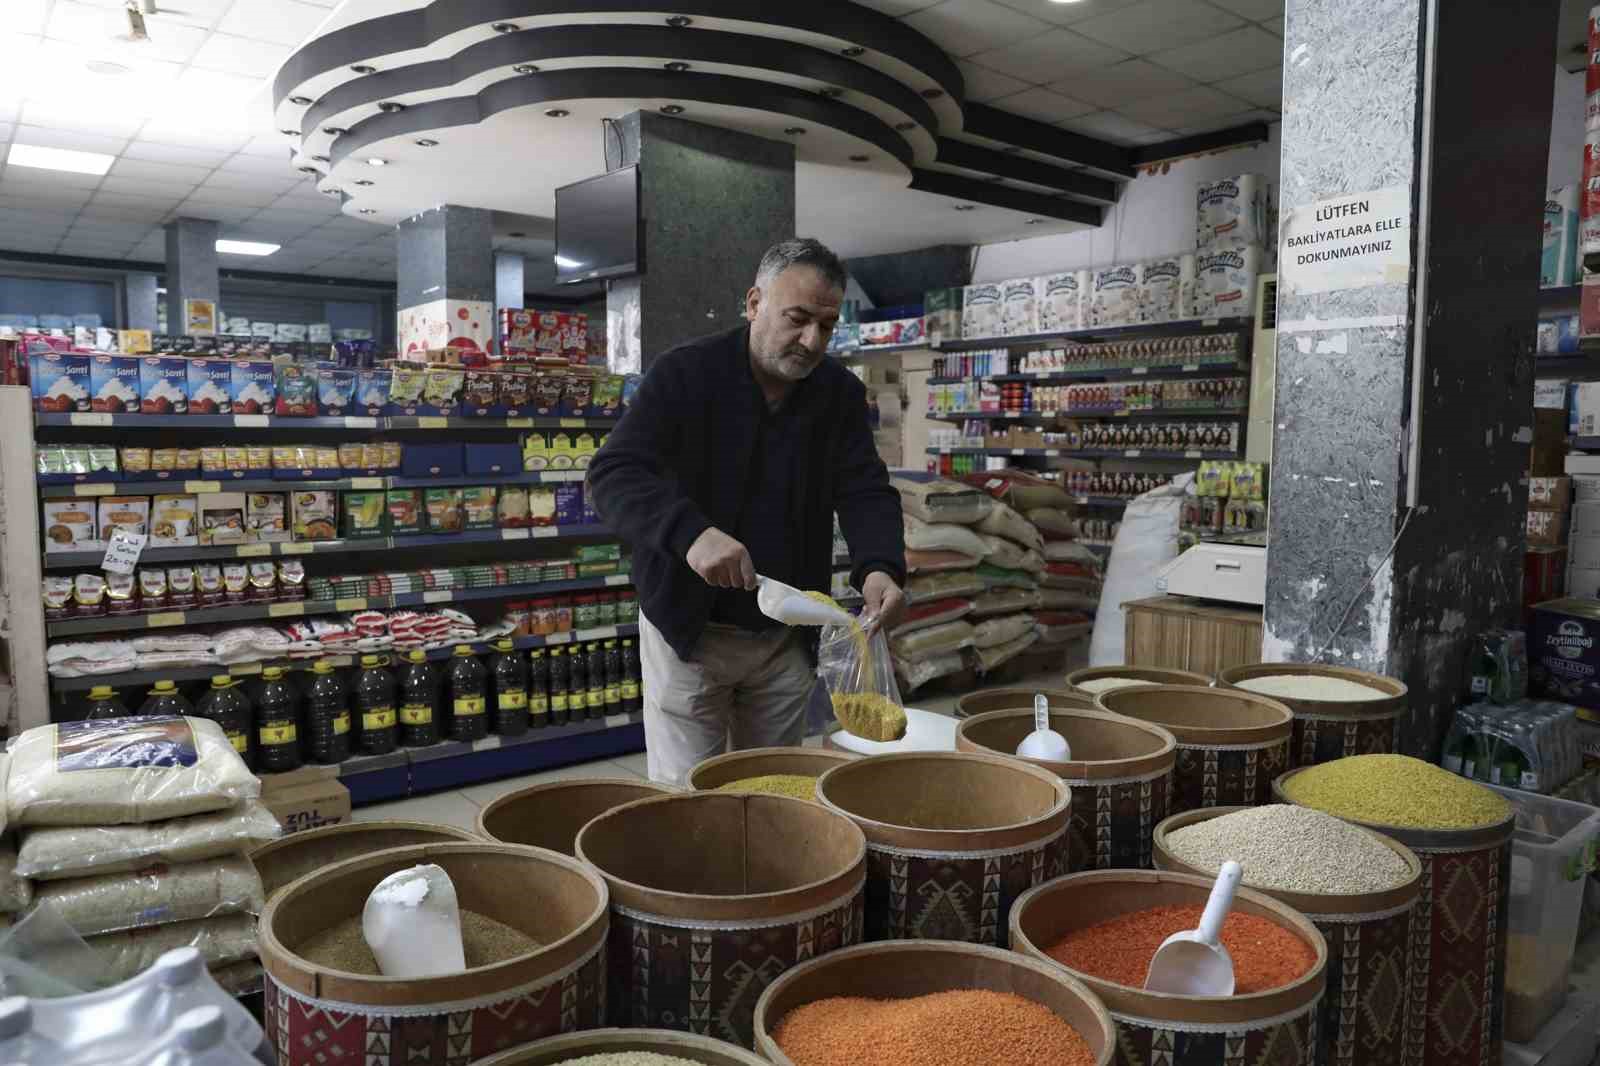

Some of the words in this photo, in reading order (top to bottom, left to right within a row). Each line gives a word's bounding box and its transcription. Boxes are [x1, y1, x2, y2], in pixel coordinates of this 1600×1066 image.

[1316, 200, 1369, 222] LÜTFEN
[1287, 224, 1372, 248] BAKLİYATLARA
[1375, 218, 1401, 232] ELLE
[1297, 240, 1392, 265] DOKUNMAYINIZ
